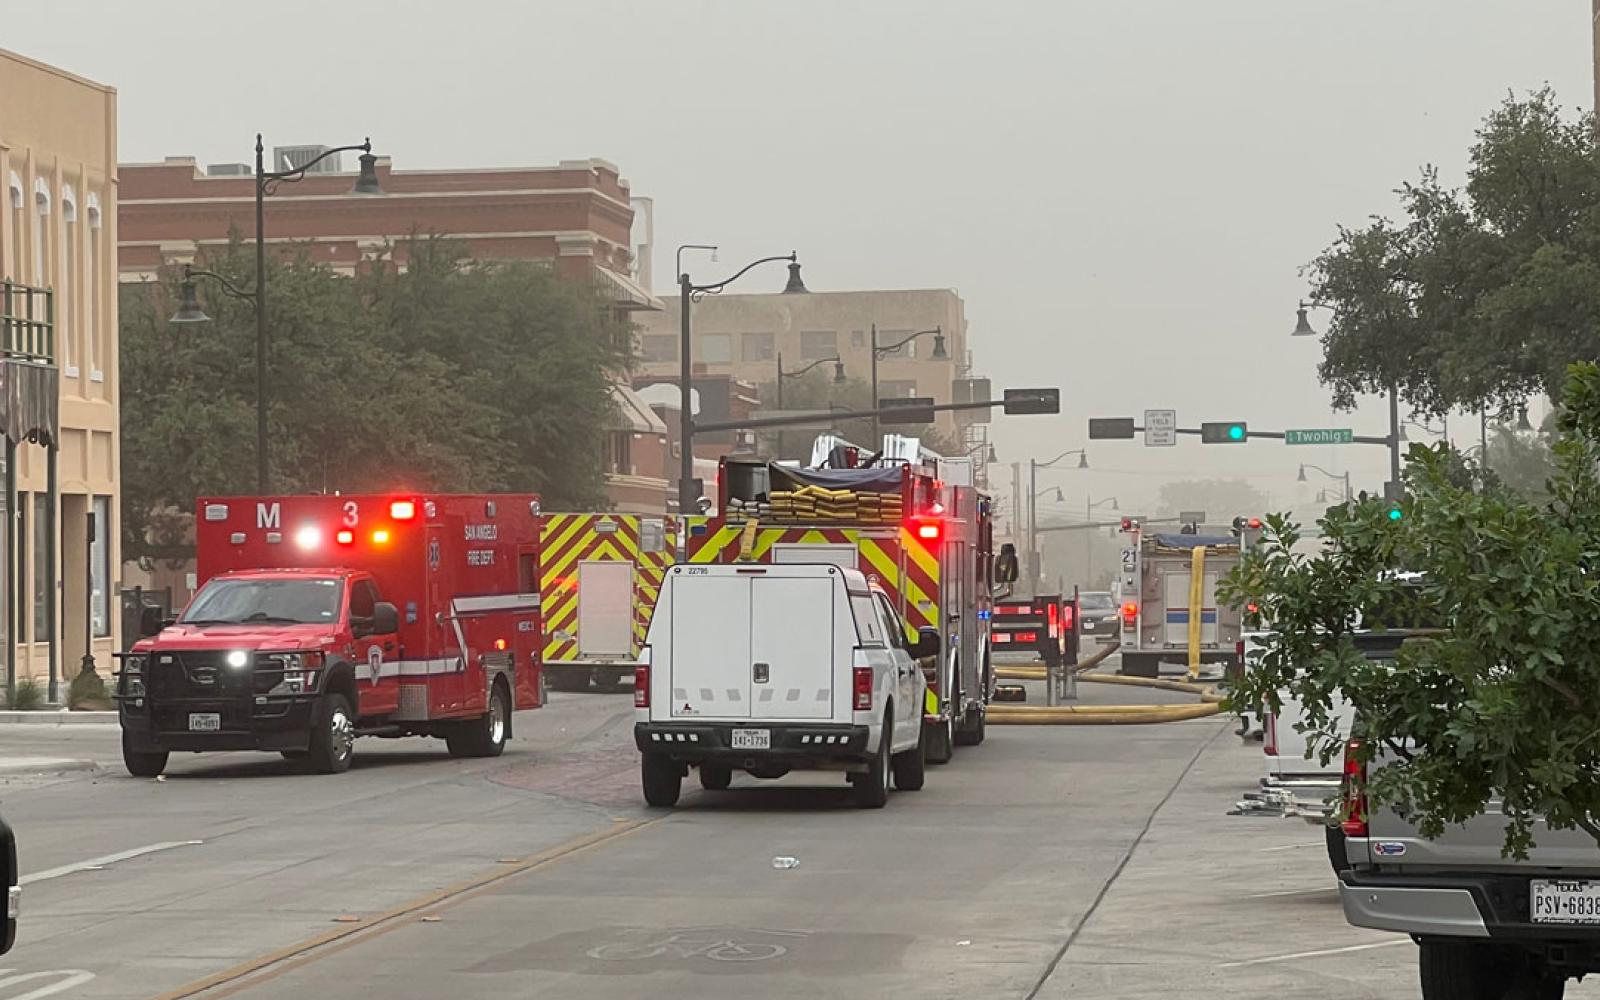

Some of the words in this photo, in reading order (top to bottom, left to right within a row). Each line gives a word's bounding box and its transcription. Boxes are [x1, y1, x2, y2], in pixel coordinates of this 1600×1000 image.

[1297, 430, 1341, 443] Twohig
[257, 502, 281, 528] M
[343, 501, 359, 527] 3
[465, 525, 476, 540] SAN
[477, 525, 497, 540] ANGELO
[468, 550, 480, 565] FIRE
[1122, 551, 1136, 563] 21
[1555, 883, 1583, 893] TEXAS
